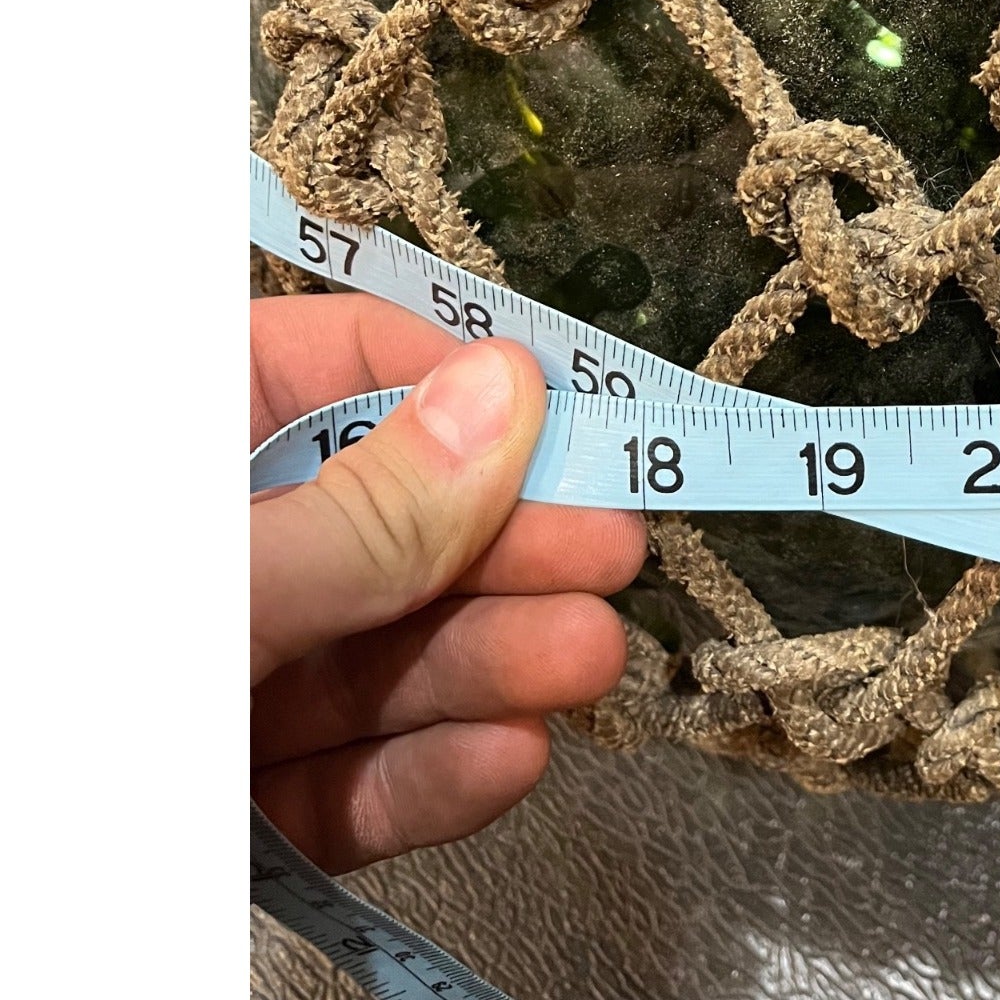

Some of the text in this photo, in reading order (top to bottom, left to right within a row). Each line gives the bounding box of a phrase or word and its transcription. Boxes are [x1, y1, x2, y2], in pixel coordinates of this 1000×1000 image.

[299, 215, 360, 276] 57
[431, 282, 494, 339] 58
[623, 435, 684, 494] 18
[799, 441, 866, 496] 19
